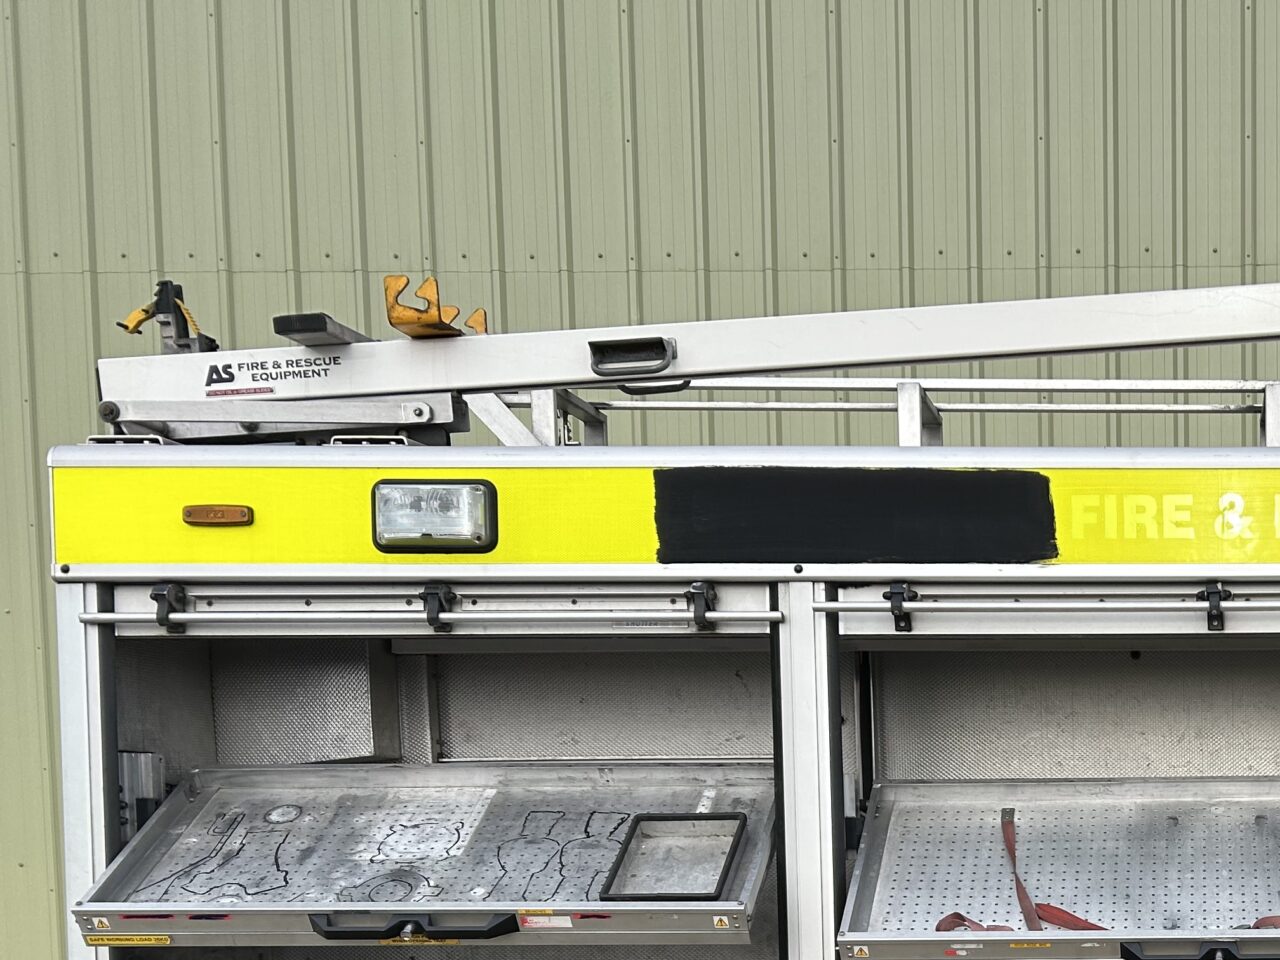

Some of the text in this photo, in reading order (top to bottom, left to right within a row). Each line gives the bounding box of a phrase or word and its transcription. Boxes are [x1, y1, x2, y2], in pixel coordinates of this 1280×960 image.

[237, 355, 342, 372] FIRE & RESCUE
[205, 363, 235, 387] AS
[251, 368, 331, 382] EQUIPMENT
[1069, 493, 1196, 540] FIRE
[1214, 492, 1256, 541] &
